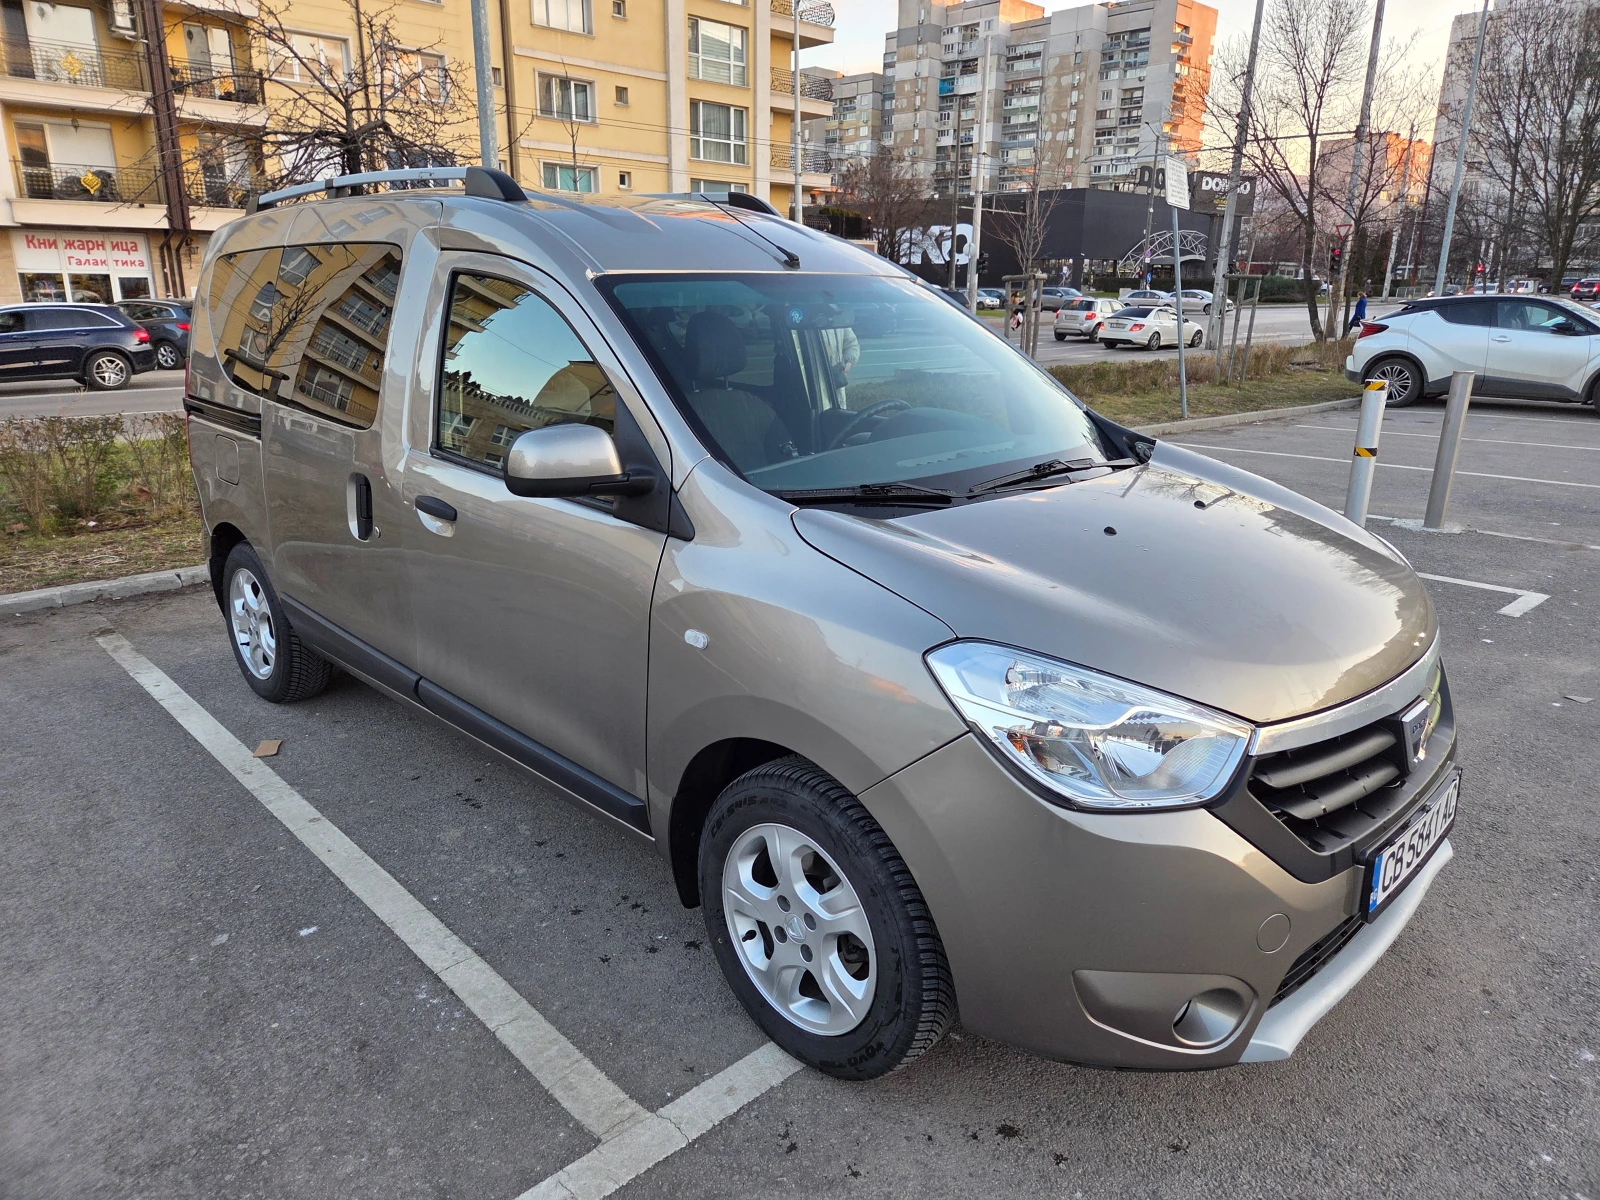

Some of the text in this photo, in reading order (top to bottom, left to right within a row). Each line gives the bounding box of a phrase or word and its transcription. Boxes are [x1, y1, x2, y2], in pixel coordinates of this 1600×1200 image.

[25, 234, 139, 255] Книжарница
[67, 256, 145, 267] Галактика
[1381, 841, 1406, 893] CB
[1406, 802, 1442, 869] 5841
